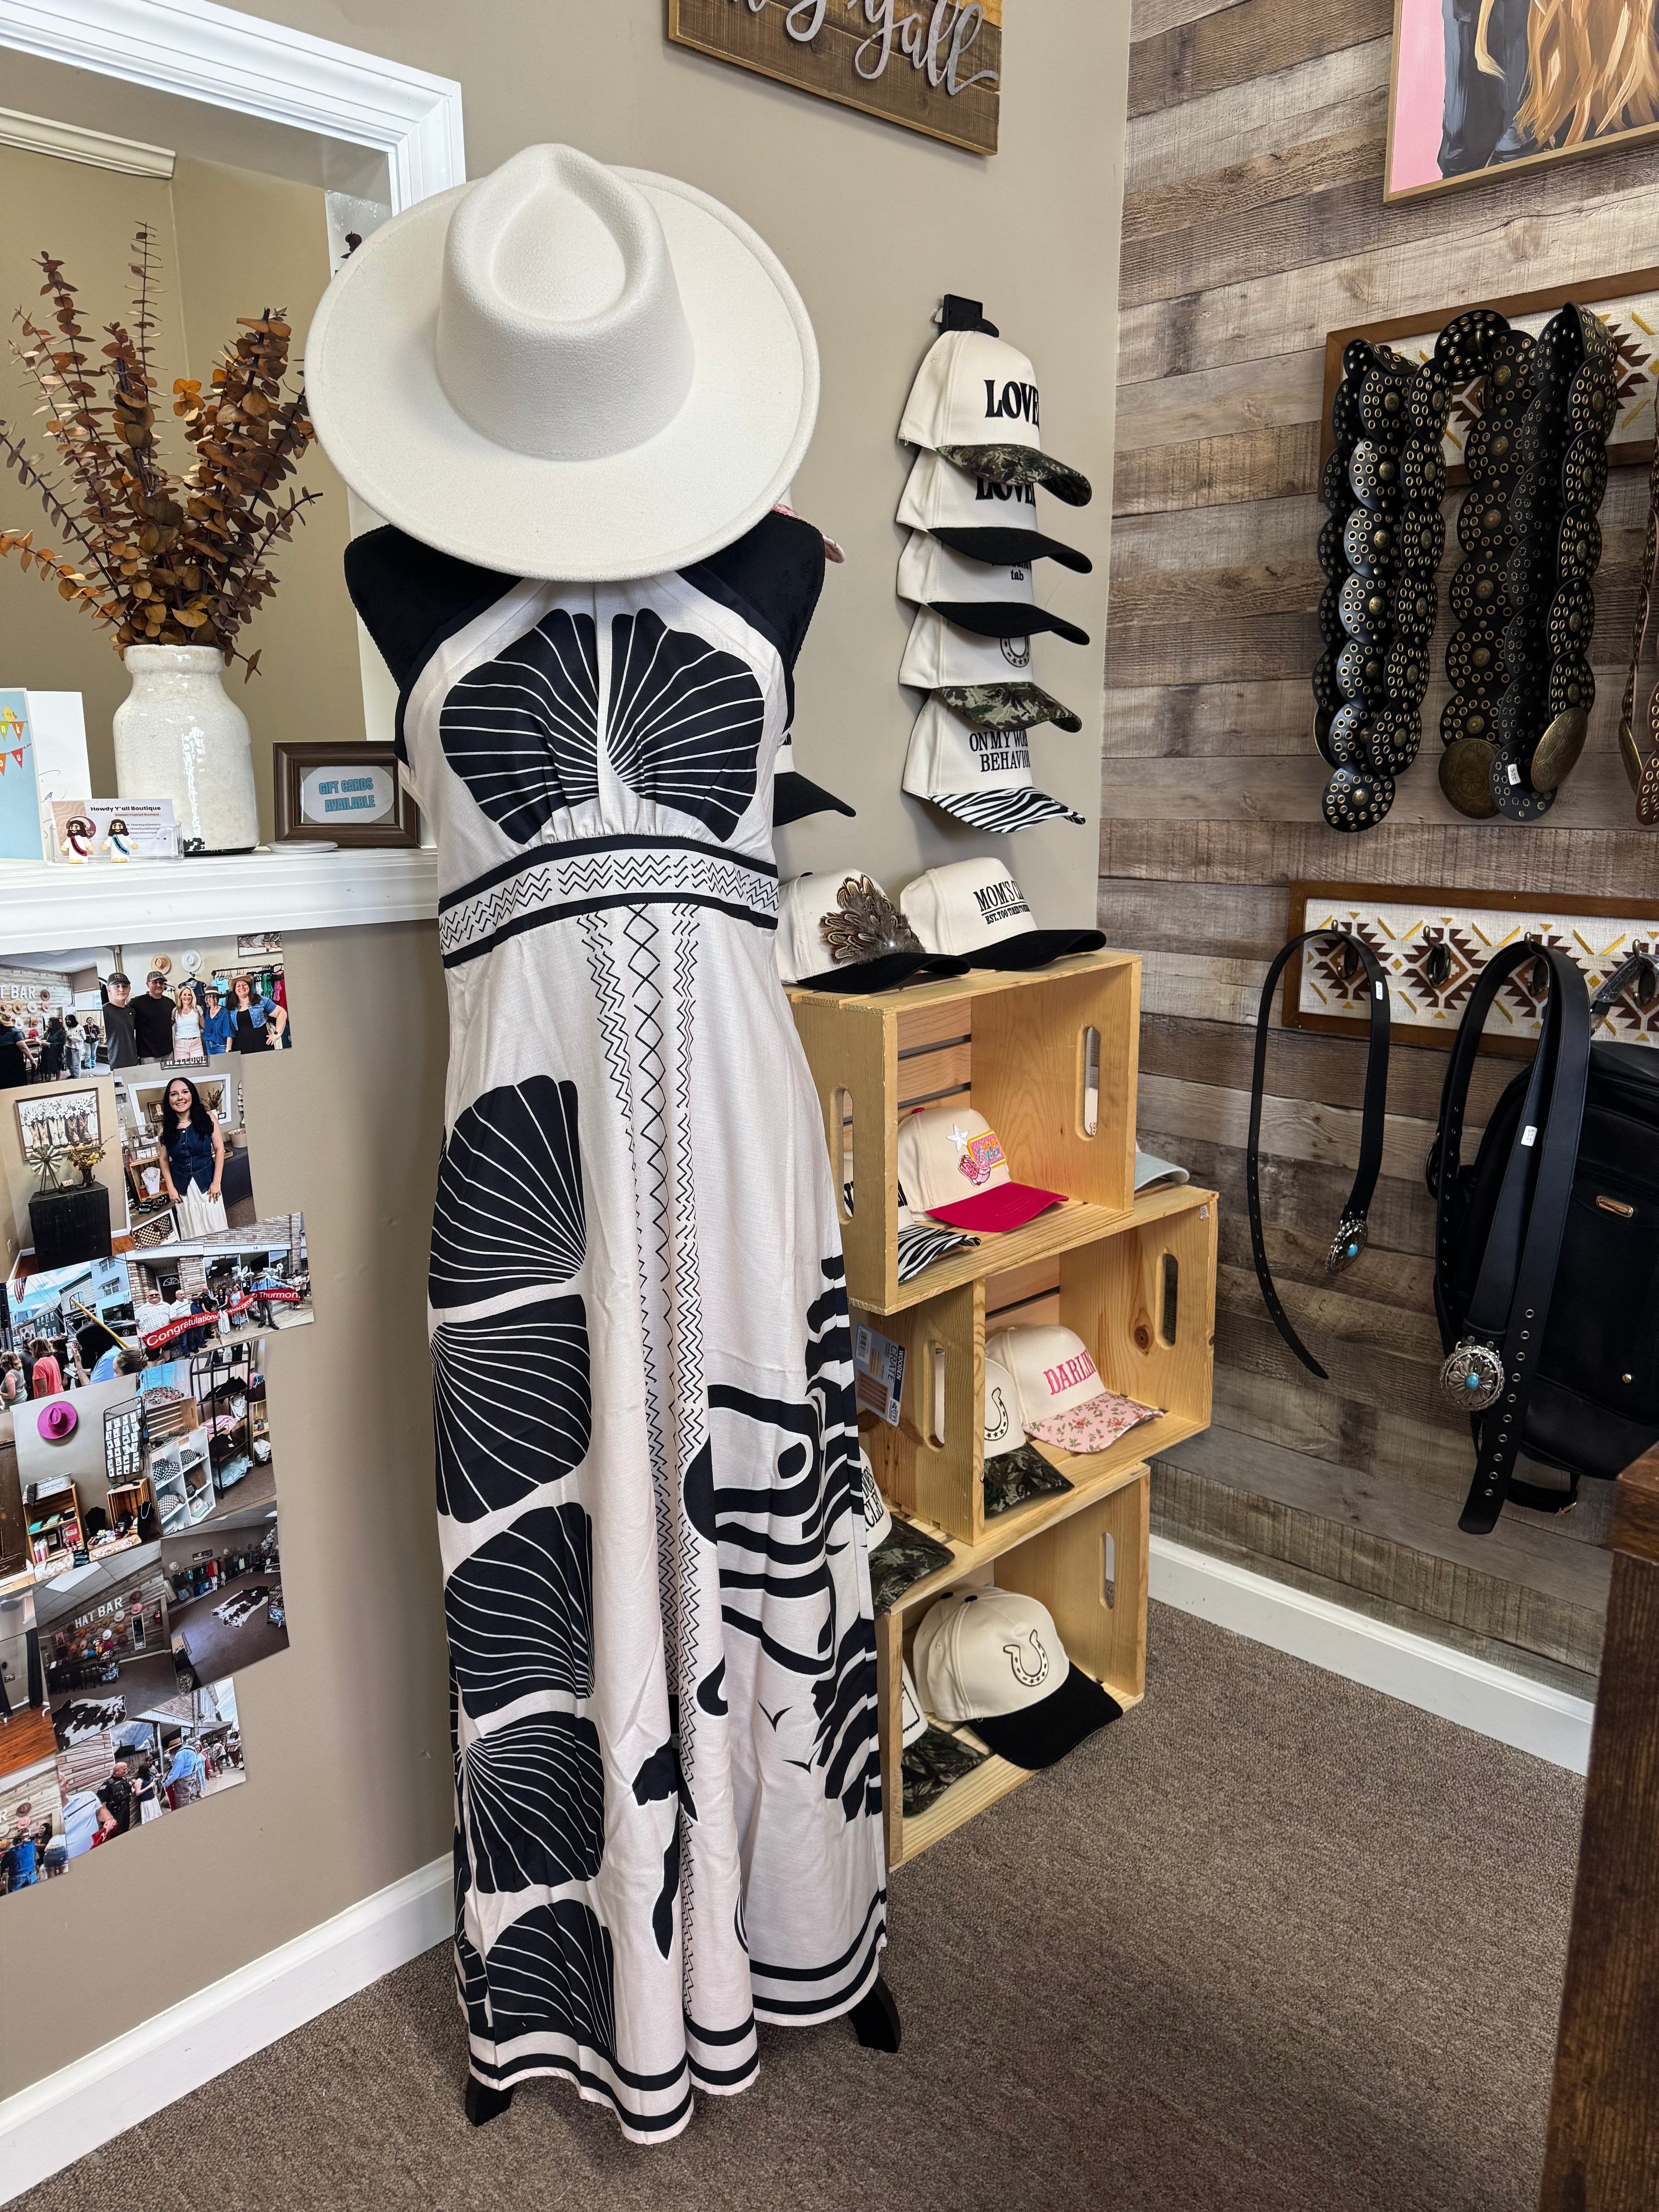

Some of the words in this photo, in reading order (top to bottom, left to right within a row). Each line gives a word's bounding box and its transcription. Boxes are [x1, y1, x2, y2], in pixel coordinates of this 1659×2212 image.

[1011, 569, 1023, 581] tab
[969, 732, 988, 751] ON
[990, 730, 1010, 749] MY
[319, 781, 339, 795] GIFT
[341, 777, 373, 792] CARDS
[325, 795, 375, 812] AVAILABLE
[973, 880, 1015, 912] MOM'S
[985, 912, 999, 925] EST.
[997, 909, 1008, 920] TOO
[10, 985, 36, 999] BAR
[888, 1346, 898, 1383] CRATE
[896, 1350, 904, 1380] WOODEN
[75, 1611, 95, 1629] HAT
[98, 1596, 123, 1618] BAR
